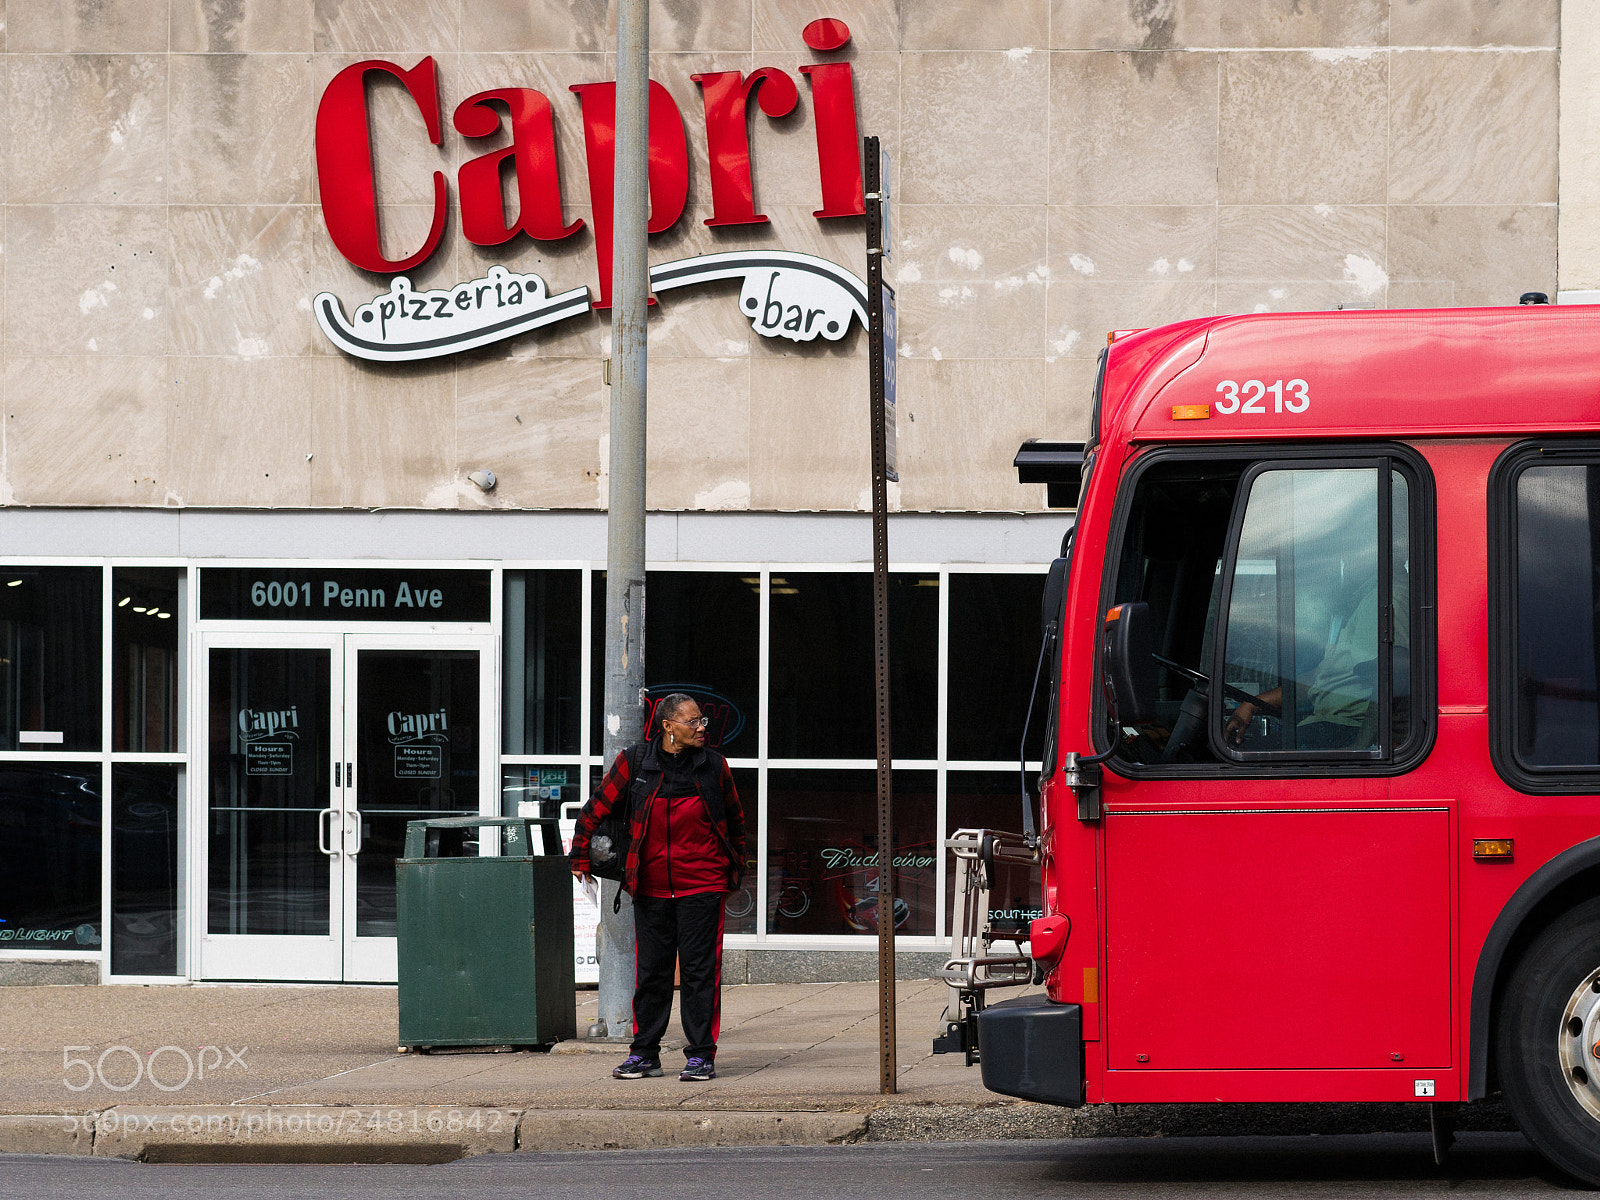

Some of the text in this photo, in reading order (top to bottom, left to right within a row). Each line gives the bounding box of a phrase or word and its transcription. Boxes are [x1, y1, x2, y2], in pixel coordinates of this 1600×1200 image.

[314, 18, 867, 311] Capri
[379, 272, 523, 341] pizzeria
[760, 271, 826, 334] bar
[1214, 378, 1311, 415] 3213
[251, 580, 444, 608] 6001 Penn Ave
[238, 705, 299, 737] Capri
[387, 708, 448, 740] Capri
[403, 747, 433, 755] Hours
[820, 848, 937, 869] Budeiser
